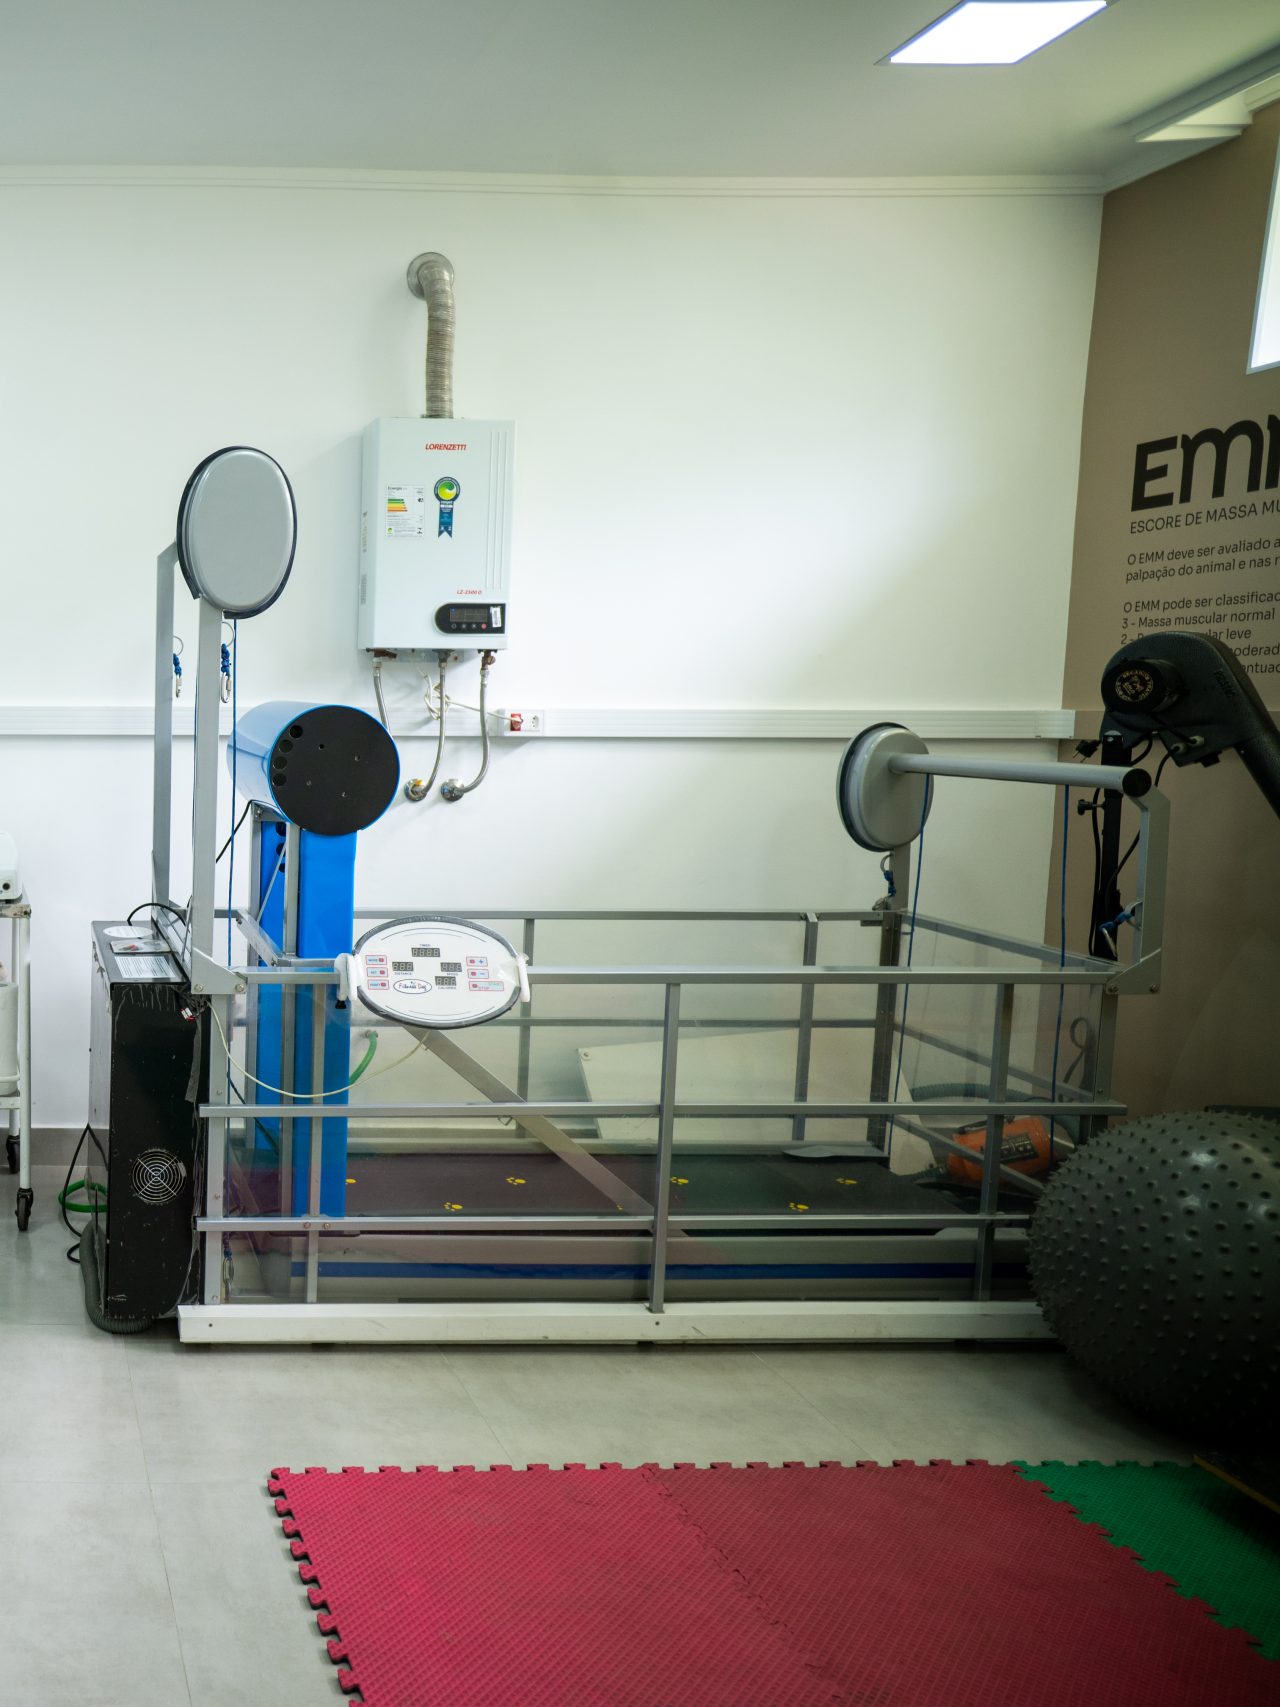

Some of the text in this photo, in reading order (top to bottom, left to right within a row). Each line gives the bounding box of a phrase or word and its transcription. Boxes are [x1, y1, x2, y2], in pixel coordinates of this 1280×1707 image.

[425, 443, 467, 451] LORENZETTI
[1130, 513, 1182, 534] ESCORE
[1185, 511, 1203, 526] DE
[1206, 503, 1258, 523] MASSA
[1127, 553, 1137, 566] O
[1138, 550, 1164, 564] EMM
[1166, 547, 1195, 561] deve
[1197, 544, 1216, 557] ser
[1218, 537, 1271, 556] avaliado
[1125, 564, 1176, 584] palpação
[1178, 563, 1194, 576] do
[1196, 558, 1236, 574] animal
[1238, 559, 1246, 570] e
[1249, 557, 1272, 569] nas
[1123, 601, 1132, 613] O
[1134, 599, 1160, 613] EMM
[1162, 594, 1192, 612] pode
[1194, 594, 1213, 608] ser
[1121, 617, 1129, 629] 3
[1138, 615, 1172, 628] Massa
[1174, 611, 1227, 626] muscular
[1230, 608, 1276, 622] normal
[1120, 633, 1128, 645] 2
[1226, 627, 1252, 640] leve
[1232, 643, 1280, 657] oderad
